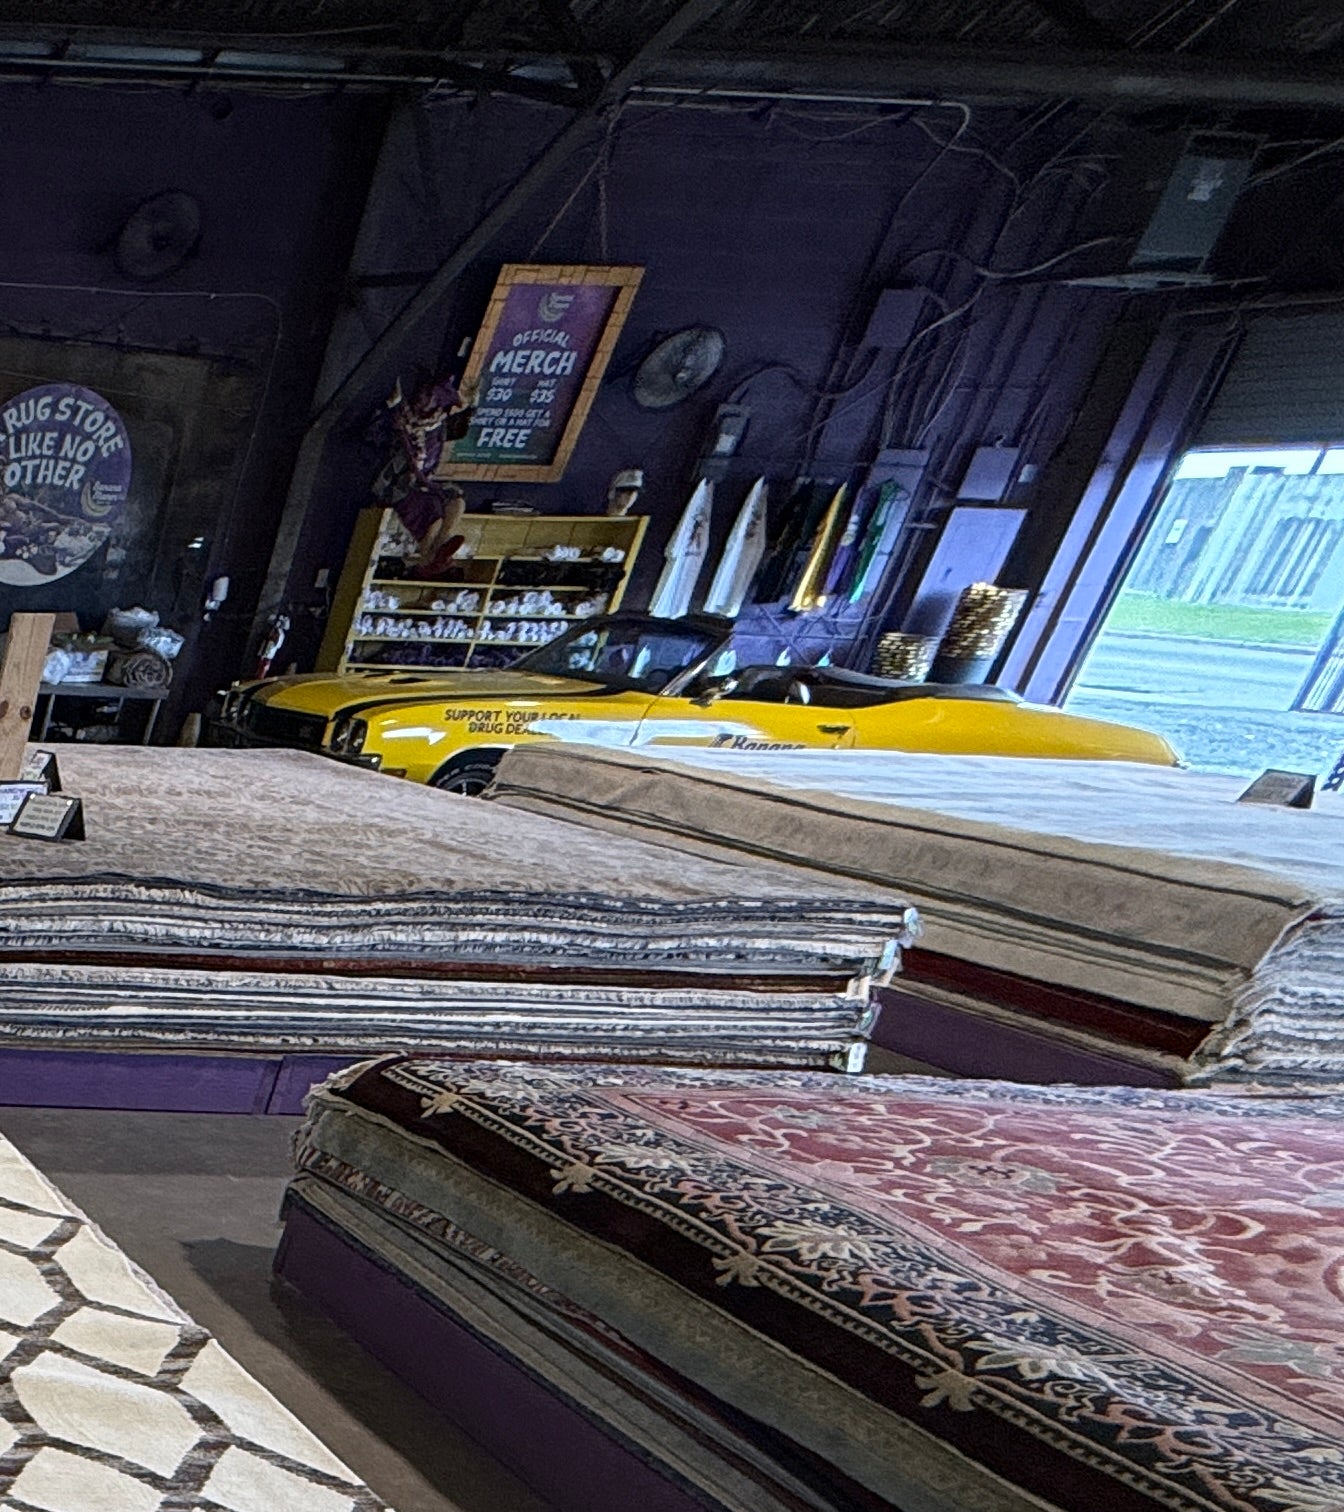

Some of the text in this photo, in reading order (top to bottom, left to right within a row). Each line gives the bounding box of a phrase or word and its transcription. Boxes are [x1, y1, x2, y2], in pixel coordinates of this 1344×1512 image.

[513, 329, 570, 347] OFFICIAL
[489, 350, 578, 376] MERCH
[486, 387, 512, 401] $30
[3, 396, 53, 434] RUG
[55, 397, 123, 458] STORE
[9, 432, 95, 463] LIKE NO
[477, 428, 531, 448] FREE
[4, 458, 86, 490] OTHER
[445, 709, 502, 722] SUPPORT
[505, 710, 539, 723] YOUR
[469, 722, 503, 733] DRUG
